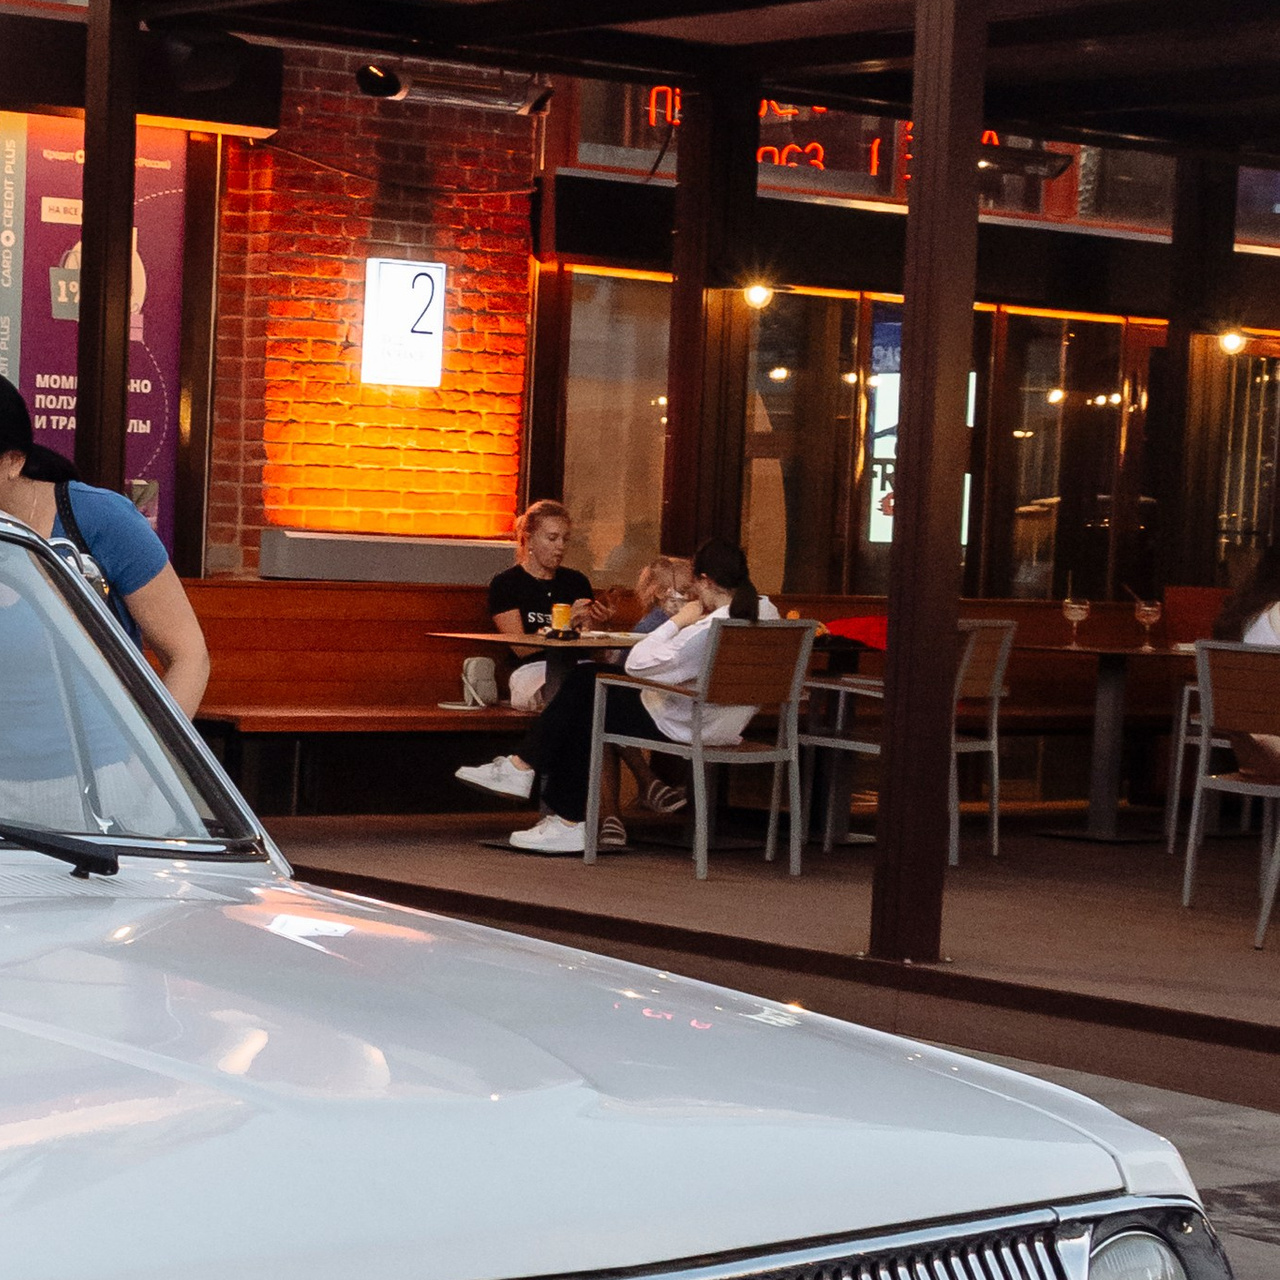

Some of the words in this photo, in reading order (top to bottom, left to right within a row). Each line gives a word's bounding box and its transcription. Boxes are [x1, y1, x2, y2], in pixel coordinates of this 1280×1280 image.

[4, 139, 17, 175] PLUS
[2, 179, 15, 228] CREDIT
[0, 249, 13, 288] CARD
[410, 272, 435, 335] 2
[0, 315, 11, 352] PLUS
[34, 414, 47, 429] И
